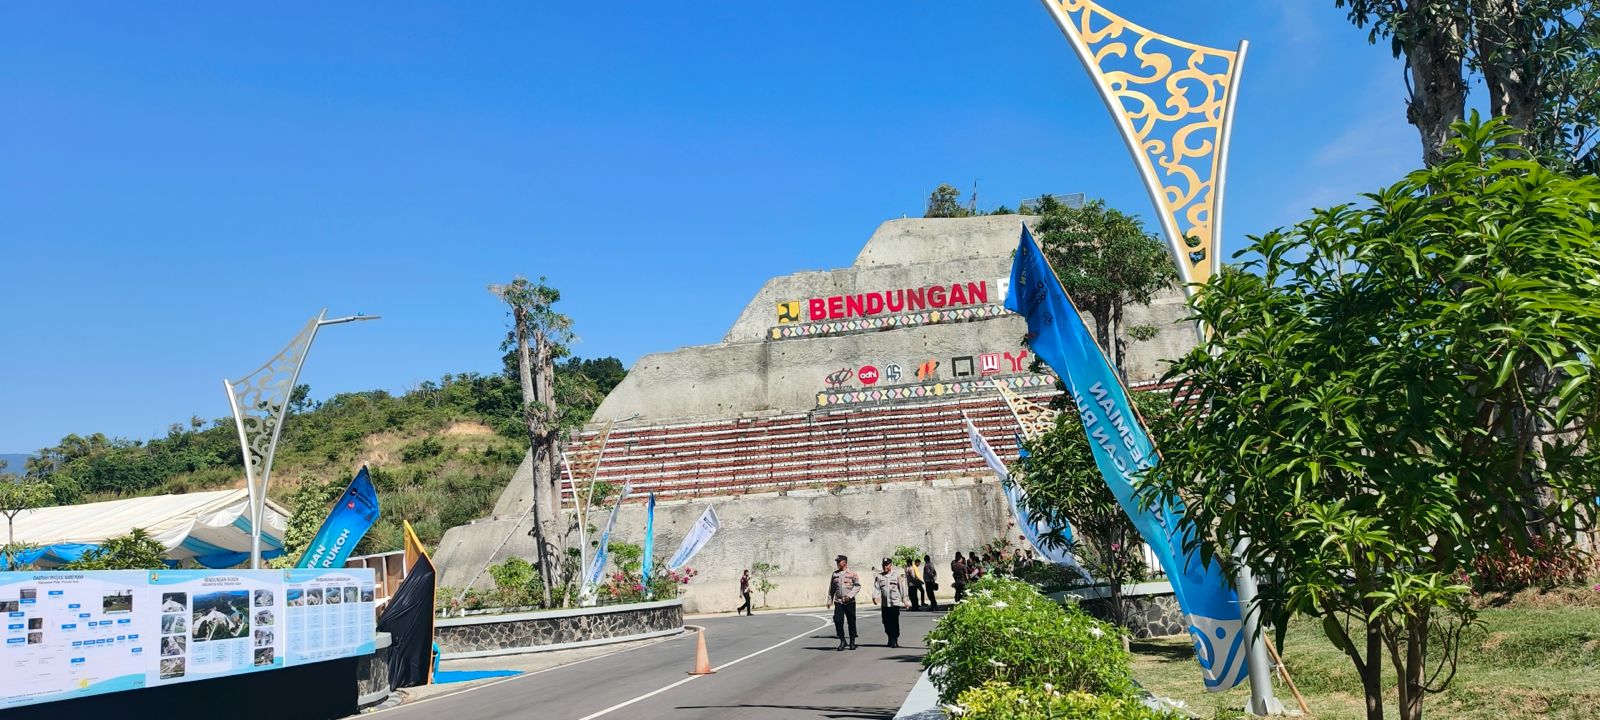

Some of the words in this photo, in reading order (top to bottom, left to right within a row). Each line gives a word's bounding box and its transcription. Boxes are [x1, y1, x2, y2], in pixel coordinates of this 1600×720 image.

[809, 281, 988, 321] BENDUNGAN
[859, 370, 877, 379] adhi
[322, 528, 351, 568] RUKOH
